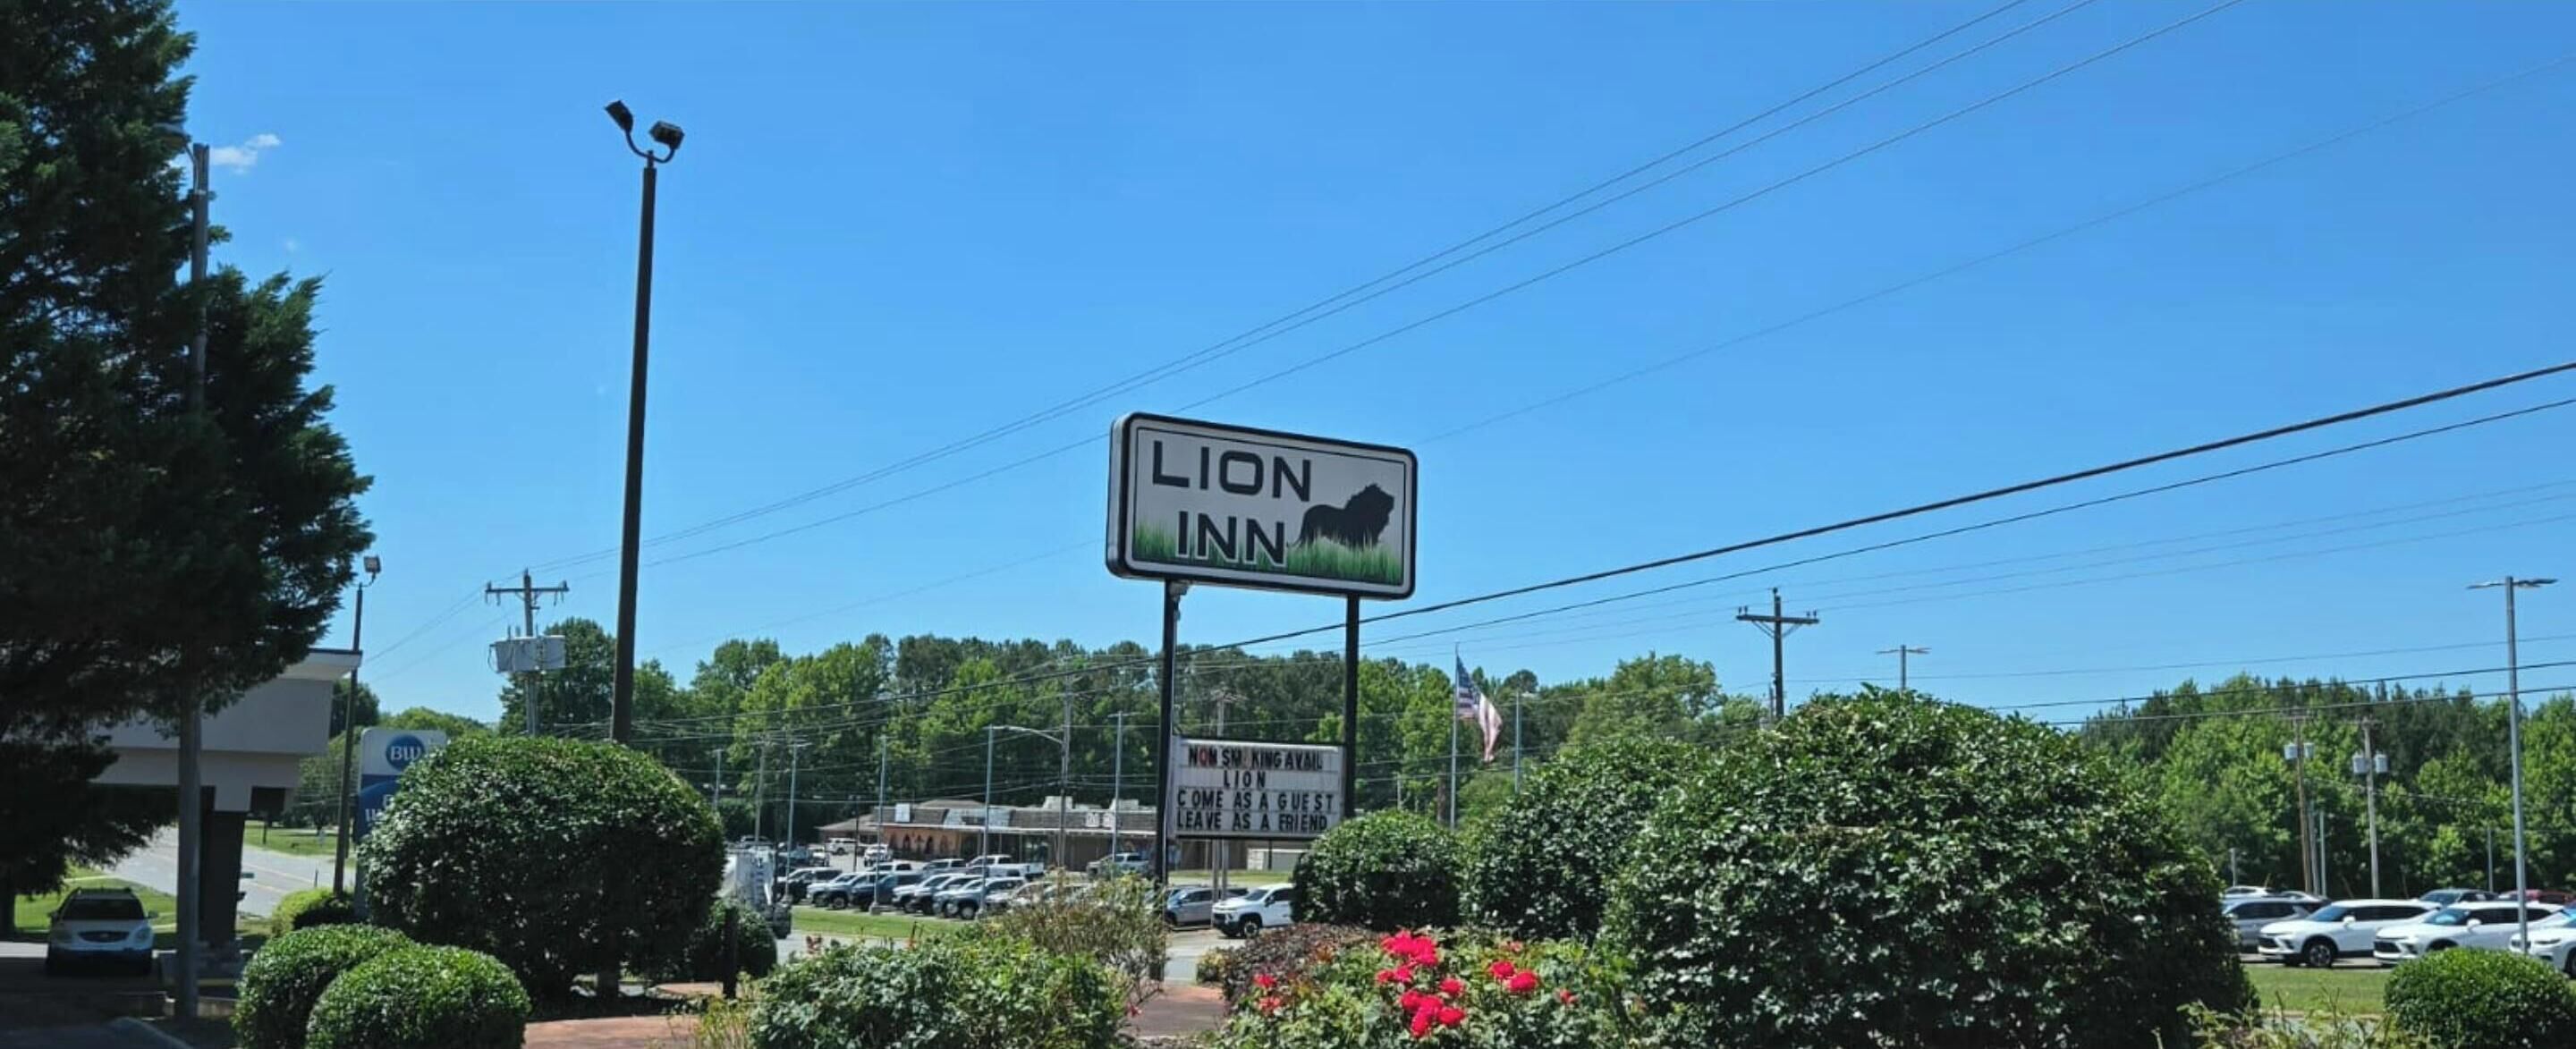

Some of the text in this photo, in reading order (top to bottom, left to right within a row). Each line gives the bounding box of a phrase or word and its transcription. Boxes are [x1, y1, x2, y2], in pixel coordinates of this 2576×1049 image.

[1152, 440, 1312, 503] LION
[1176, 511, 1285, 566] INN
[391, 746, 421, 761] BW
[1189, 746, 1323, 771] NON SMKING AVAIL
[1223, 770, 1267, 788] LION
[1177, 790, 1334, 814] COME AS A GUEST
[1176, 811, 1327, 833] LEAVE AS A FRIEND
